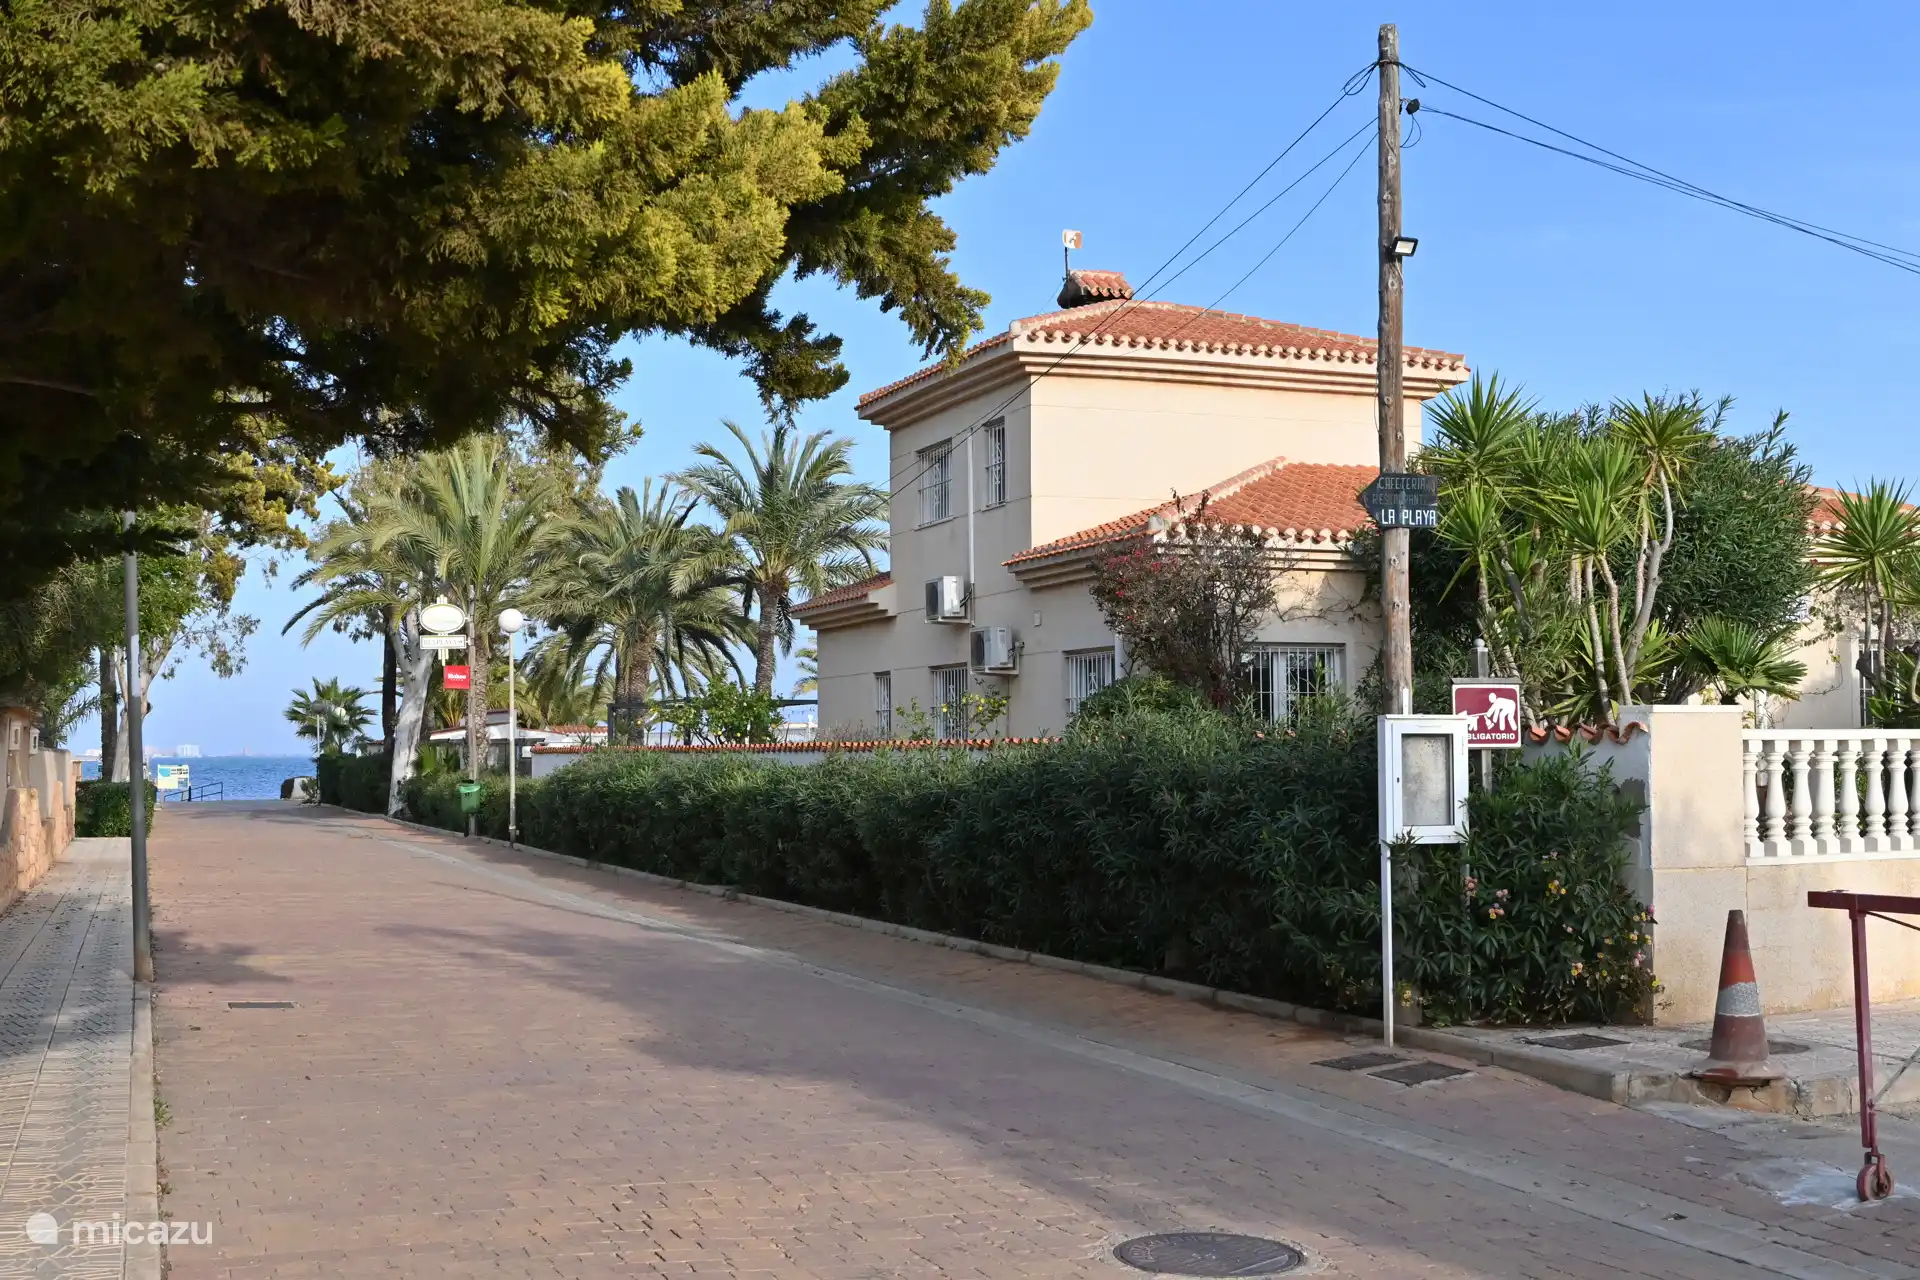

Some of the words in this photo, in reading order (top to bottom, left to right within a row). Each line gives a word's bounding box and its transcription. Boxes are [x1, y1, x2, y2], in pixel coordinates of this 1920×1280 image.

[1378, 477, 1425, 490] CAFETERIA
[1381, 508, 1395, 525] LA
[1402, 509, 1436, 526] PLAYA
